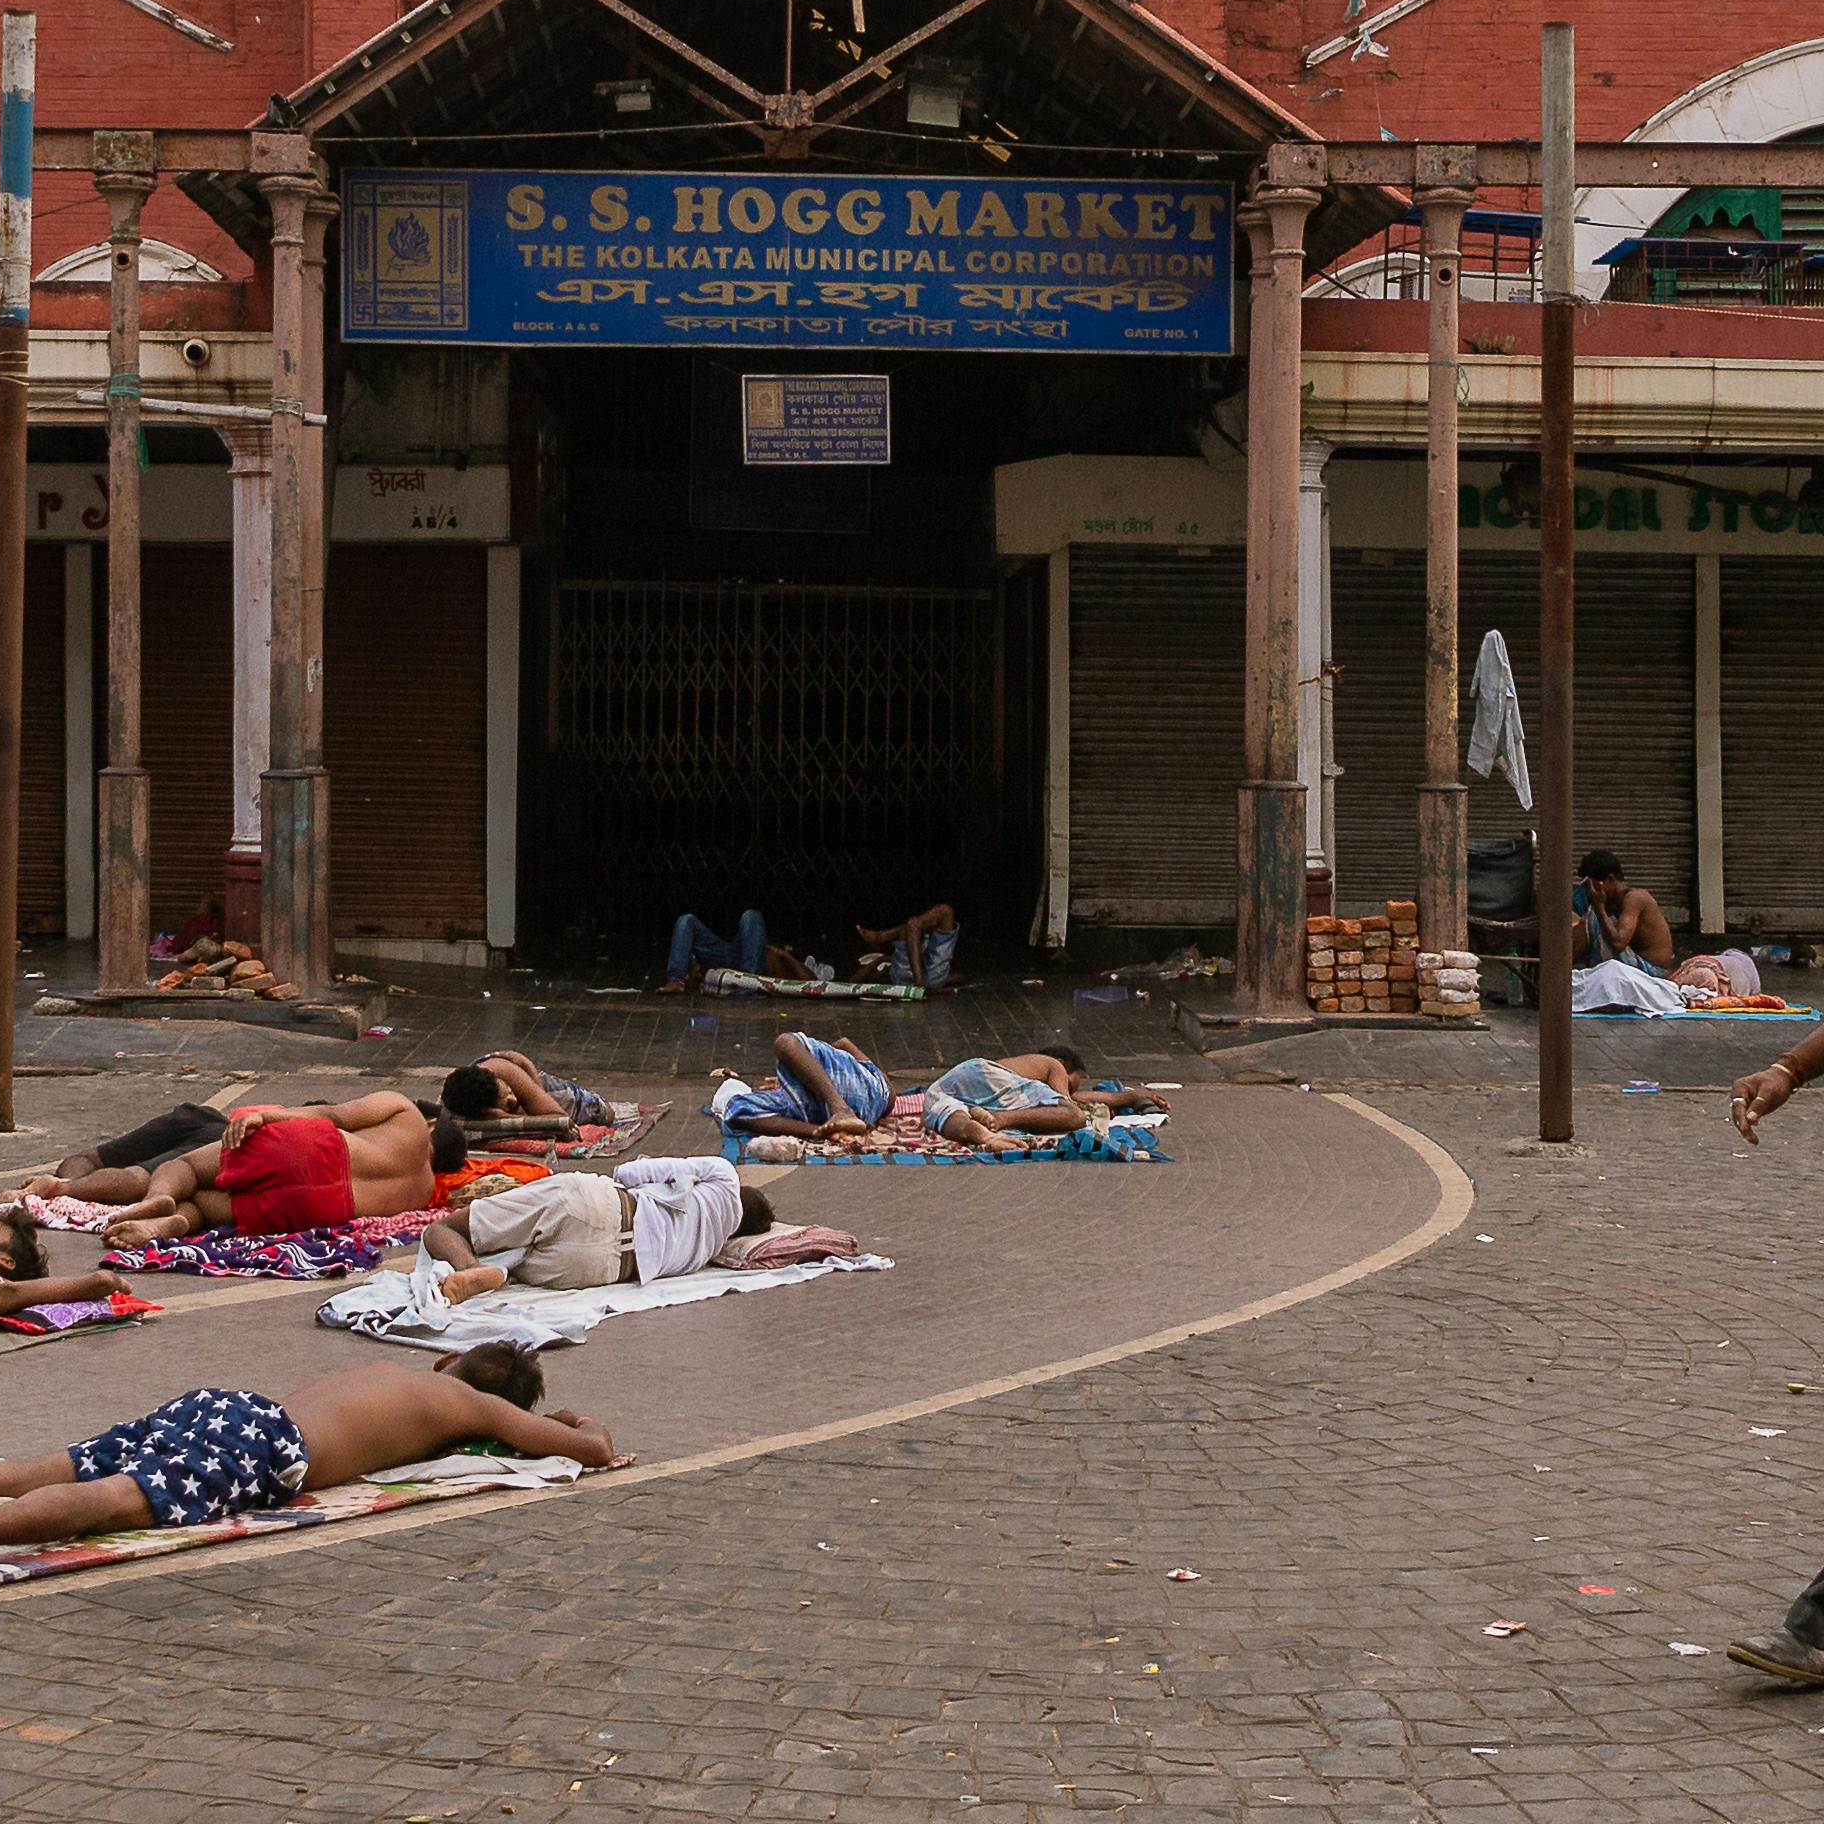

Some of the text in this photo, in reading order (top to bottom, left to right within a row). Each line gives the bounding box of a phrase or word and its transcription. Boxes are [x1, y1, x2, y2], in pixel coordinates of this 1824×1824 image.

[505, 183, 1227, 241] S. S. HOGG MARKET
[517, 243, 1215, 278] THE KOLKATA MUNICIPAL CORPORATION
[951, 279, 1194, 312] মার্কেট
[512, 321, 554, 332] BLOCK
[564, 322, 573, 332] A
[659, 312, 1069, 339] কলকাতা পৌর সংস্থা
[1123, 327, 1198, 339] GATE NO. 1
[813, 407, 841, 416] HOGG
[843, 407, 882, 416] MARKET
